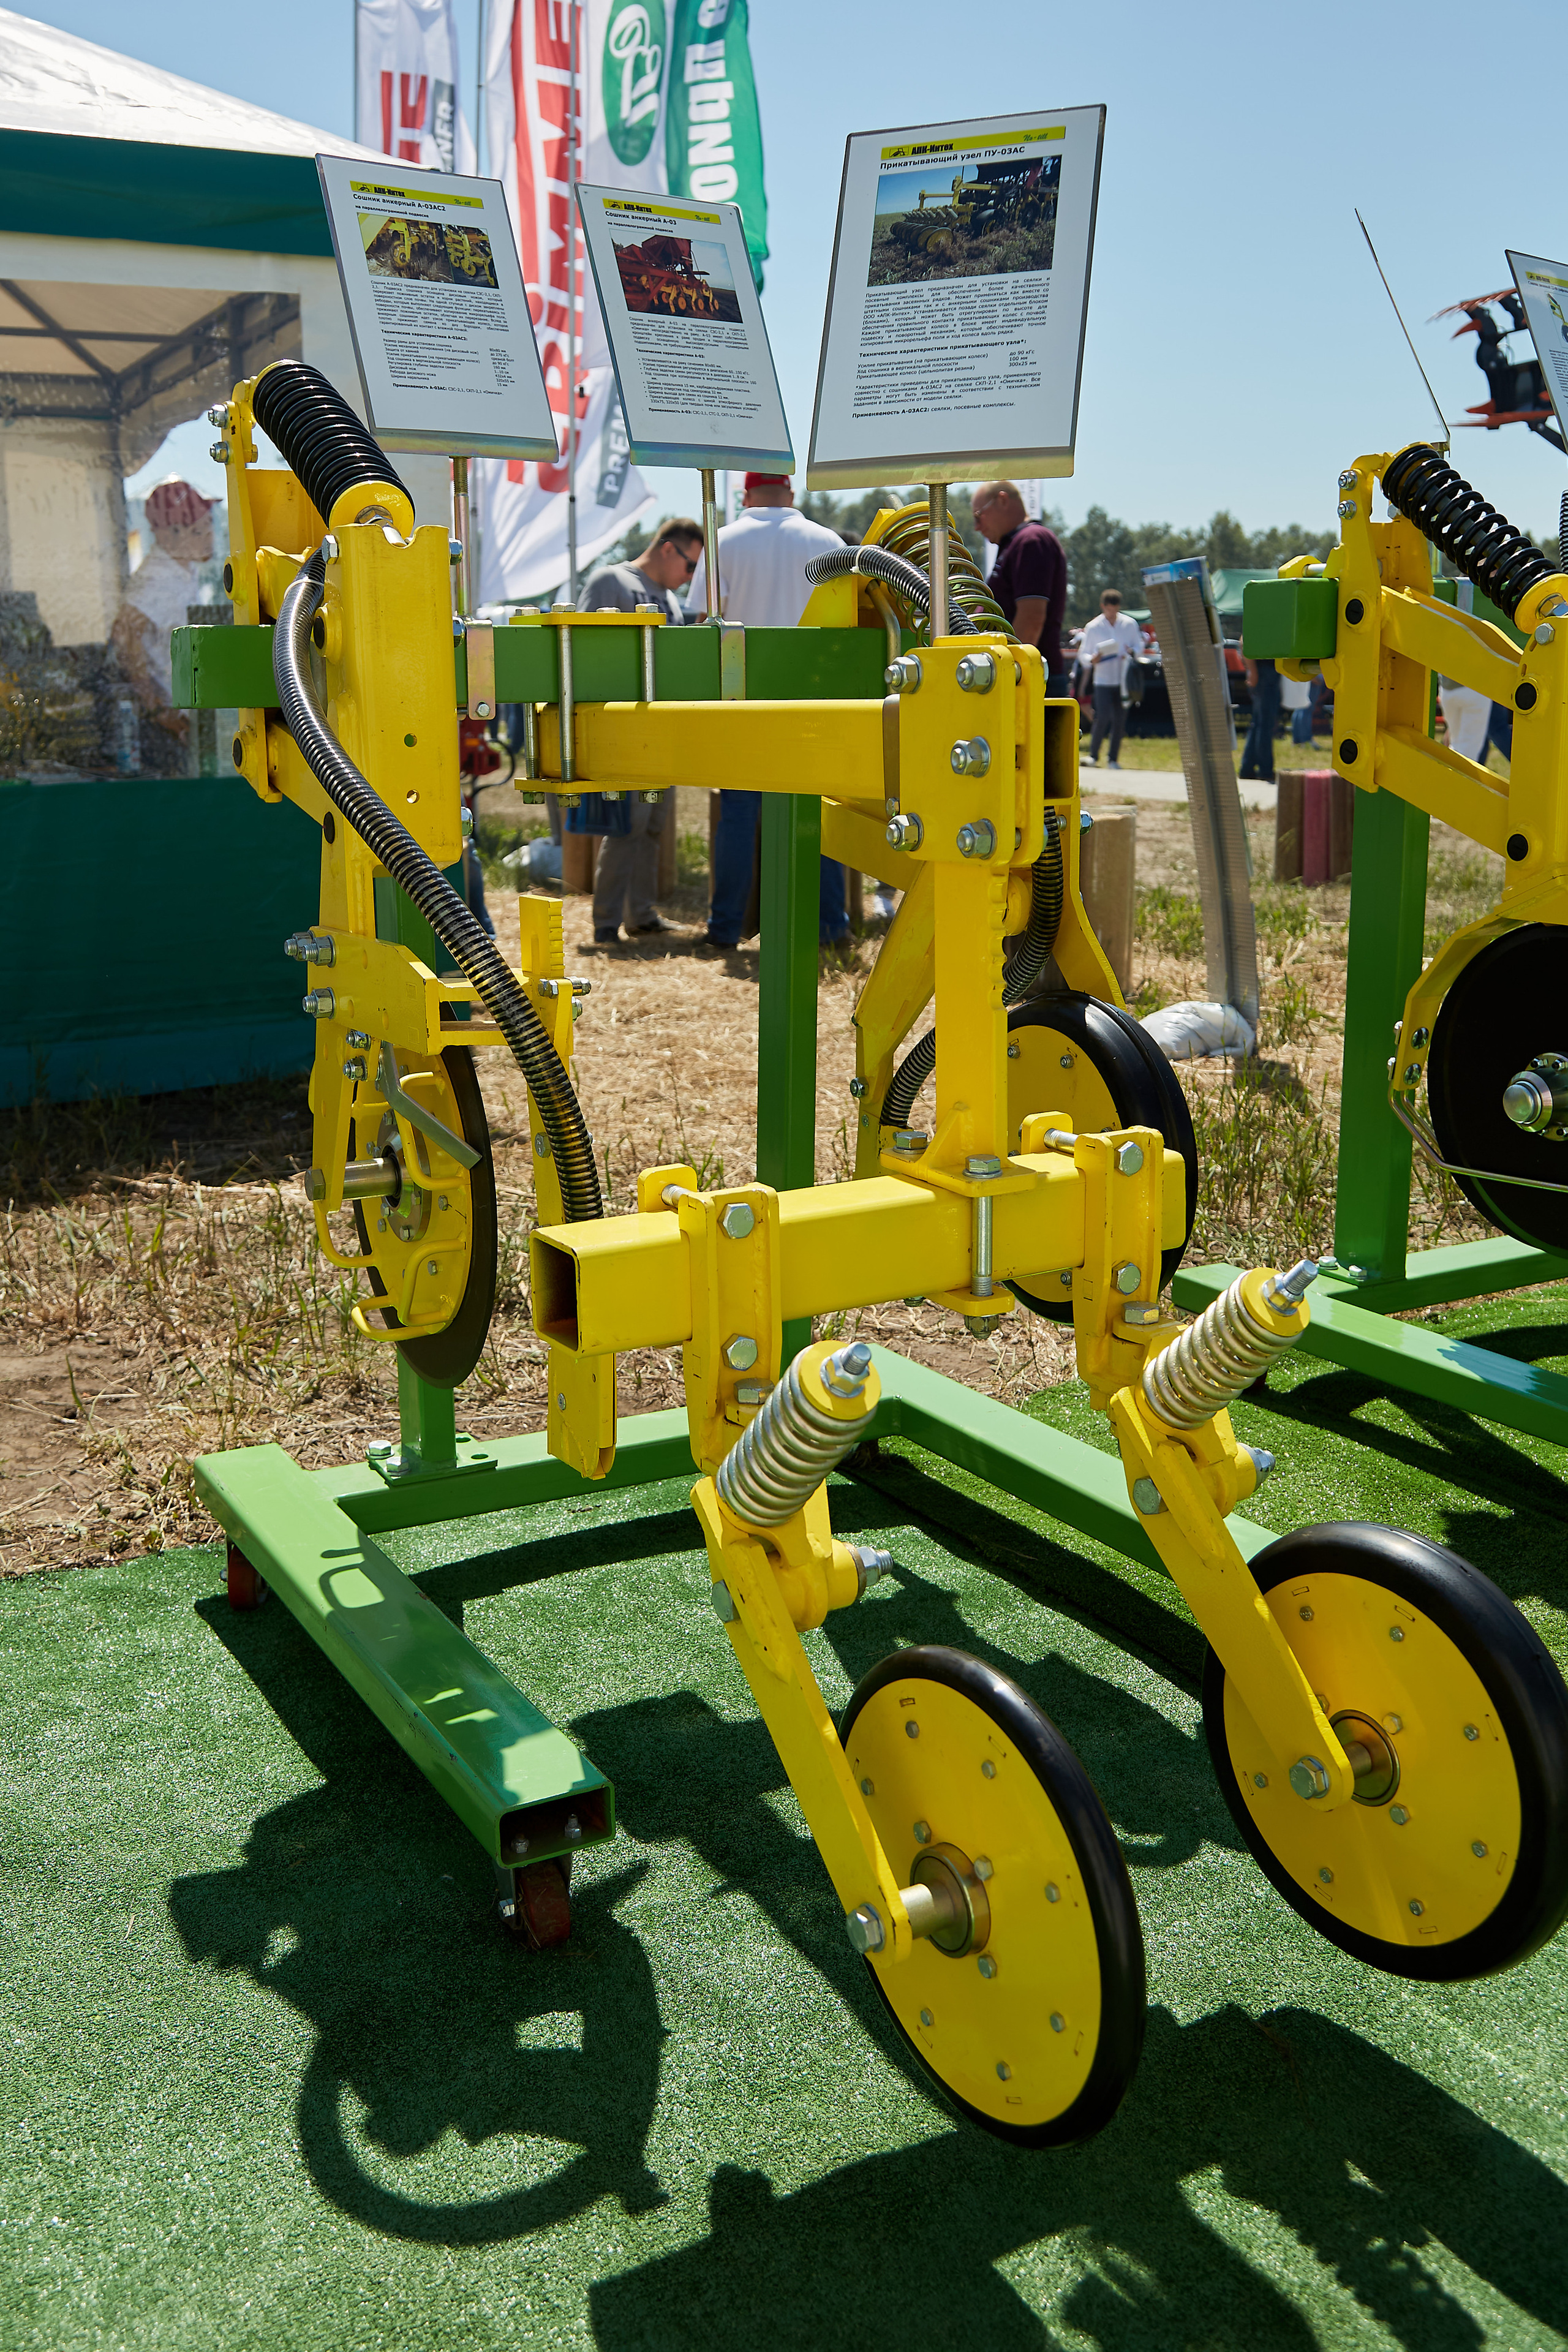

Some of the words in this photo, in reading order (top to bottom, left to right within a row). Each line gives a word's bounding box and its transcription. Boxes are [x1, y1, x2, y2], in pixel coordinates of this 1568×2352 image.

[911, 143, 954, 156] АПК-Интех
[880, 153, 958, 170] Прикатывающий
[960, 152, 982, 162] узел
[374, 186, 406, 198] АПК-Интех
[353, 194, 381, 203] Сошник
[382, 198, 417, 208] анкерный
[361, 206, 408, 215] параллелограммной
[624, 203, 653, 214] АПК-Интех
[605, 211, 630, 219] Сошник
[613, 222, 655, 231] параллелограммной
[865, 289, 908, 298] Прикатывающий
[927, 284, 964, 293] предназначен
[864, 301, 900, 309] прикатывания
[913, 306, 957, 315] Устанавливается
[862, 317, 890, 326] (блоками),
[957, 314, 1000, 322] прикатывающих
[899, 345, 948, 355] характеристики
[949, 341, 1005, 350] прикатывающего
[924, 355, 967, 364] прикатывающем
[895, 363, 931, 371] вертикальной
[856, 372, 899, 380] Прикатывающее
[941, 375, 987, 384] прикатывающего
[852, 410, 900, 419] Применяемость
